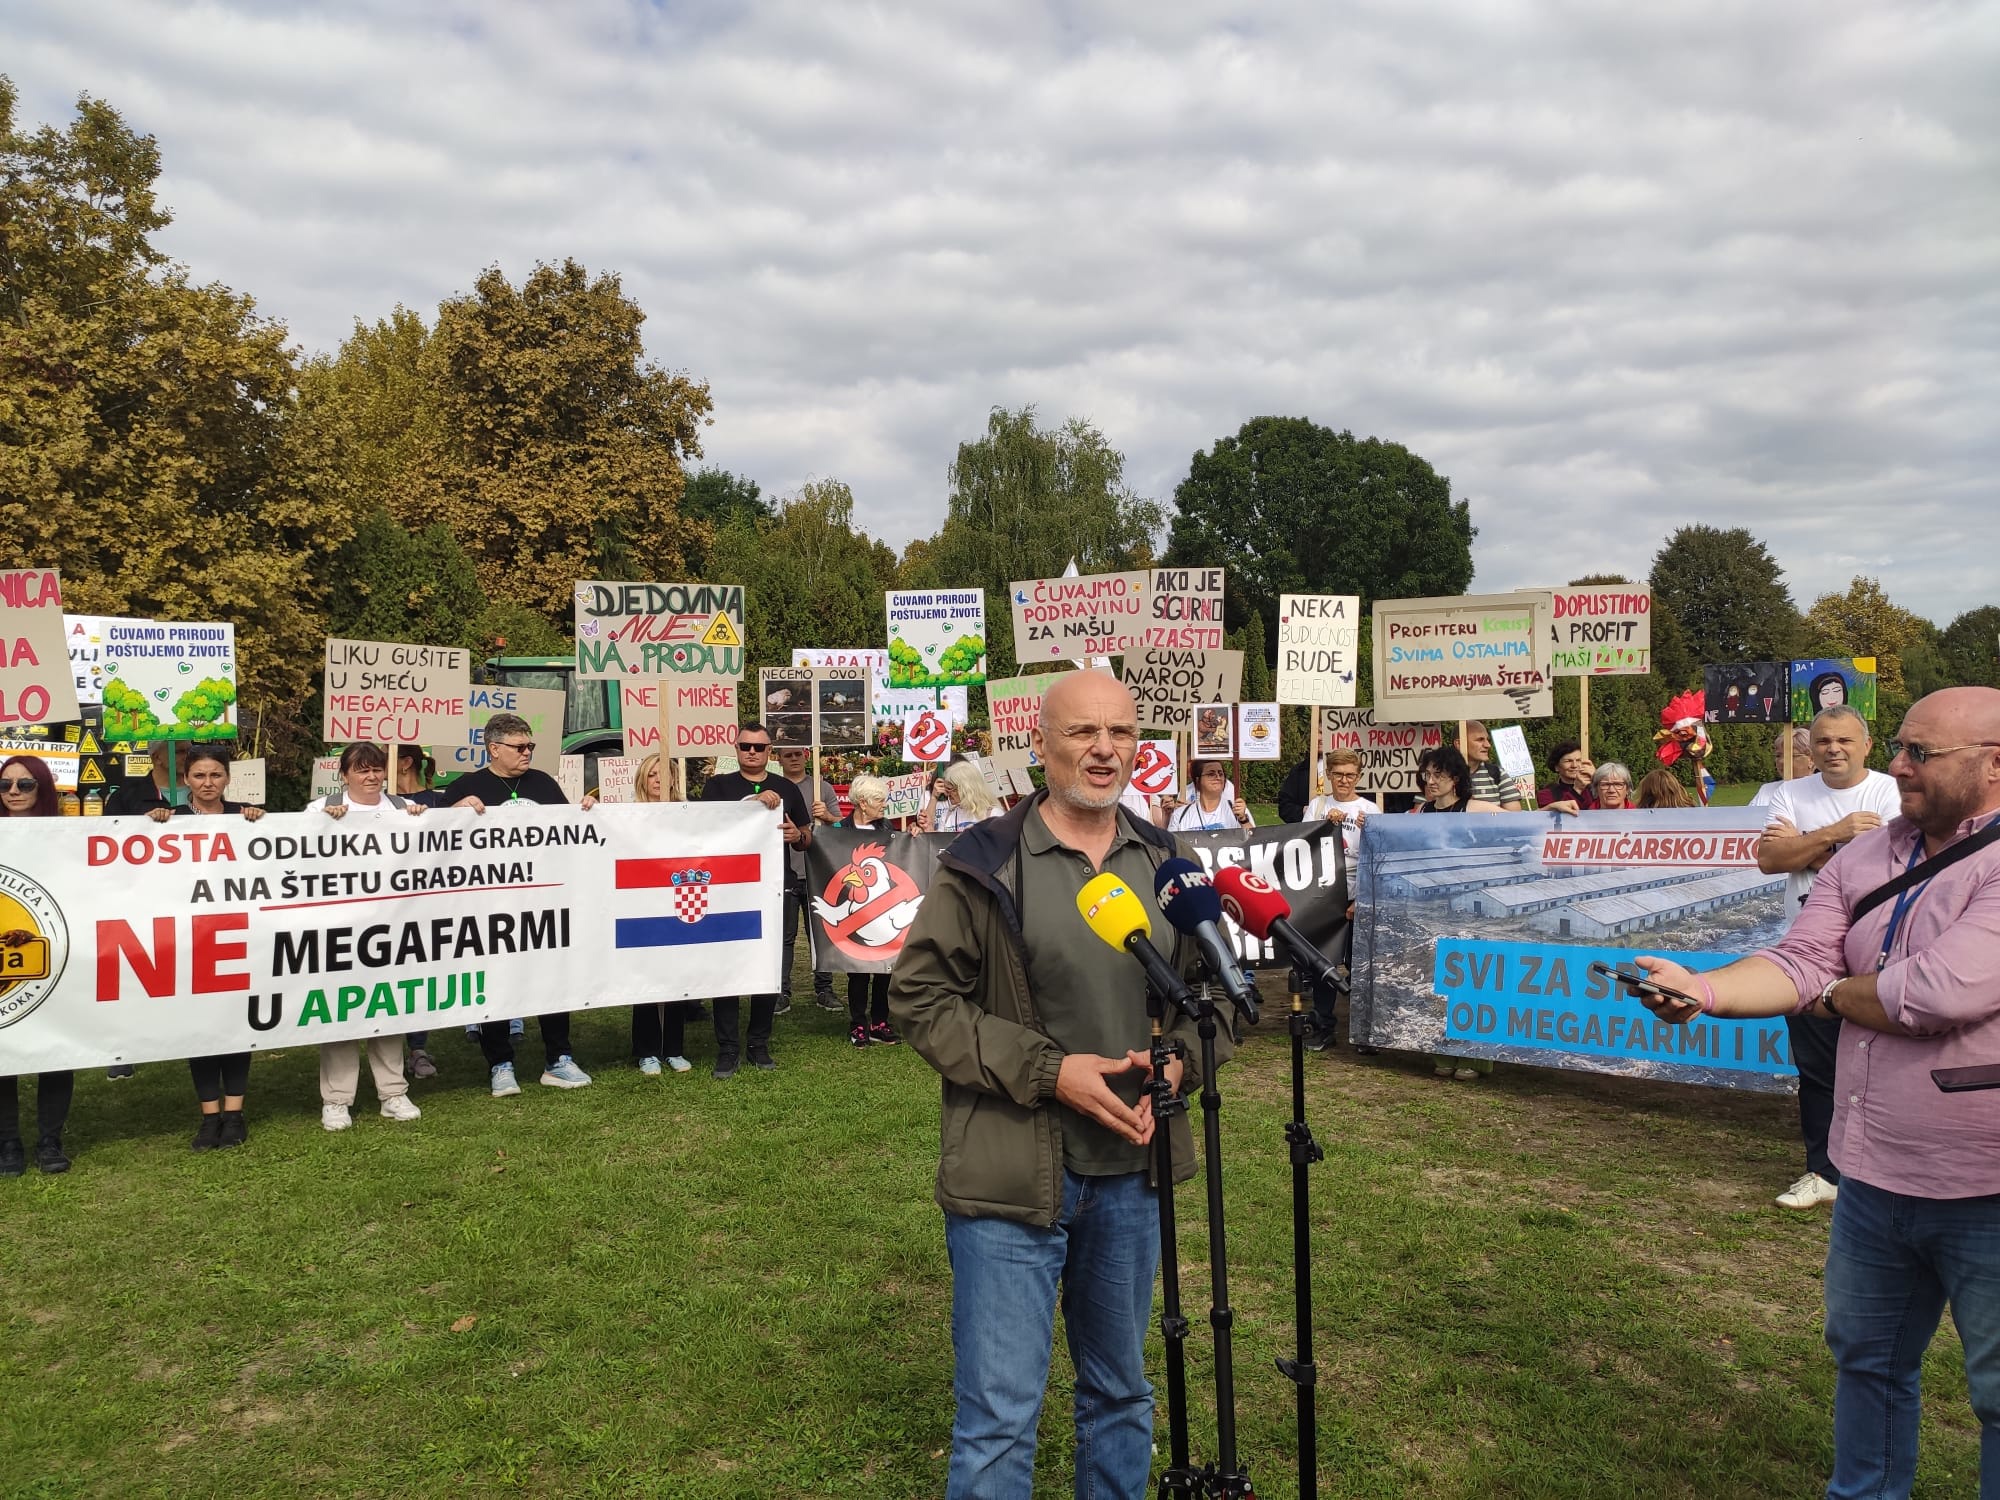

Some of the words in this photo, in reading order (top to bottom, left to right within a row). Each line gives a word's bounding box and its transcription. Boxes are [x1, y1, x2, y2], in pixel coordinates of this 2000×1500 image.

[1034, 579, 1126, 603] ČUVAJMO
[1156, 571, 1188, 591] AKO
[1195, 571, 1221, 592] JE
[584, 584, 744, 622] DJEDOVINA
[893, 594, 932, 606] ČUVAMO
[936, 594, 977, 605] PRIRODU
[1024, 598, 1140, 623] PODRAVINU
[1152, 593, 1223, 621] SIGURNO
[1290, 599, 1344, 618] NEKA
[1553, 594, 1650, 618] DOPUSTIMO
[890, 608, 947, 620] POŠTUJEMO
[950, 606, 981, 618] ŽIVOTE
[110, 626, 165, 641] ČUVAMO
[170, 628, 225, 641] PRIRODU
[617, 614, 709, 643] NIJE
[1029, 626, 1054, 640] ZA
[1064, 617, 1115, 638] NAŠU
[1280, 622, 1359, 648] BUDUĆNOST
[1390, 623, 1477, 639] PROFITERU
[1570, 621, 1638, 643] PROFIT
[106, 643, 184, 657] POŠTUJEMO
[188, 643, 230, 658] ŽIVOTE
[330, 644, 379, 665] LIKU
[391, 648, 461, 669] GUŠITE
[579, 638, 628, 674] NA
[640, 642, 744, 675] PRODAJU
[1145, 648, 1206, 669] ČUVAJ
[1287, 650, 1342, 673] BUDE
[1391, 646, 1444, 663] SVIMA
[1452, 641, 1529, 659] OSTALIMA
[762, 667, 813, 680] NEĆEMO
[830, 669, 857, 679] OVO
[1125, 667, 1204, 688] NAROD
[1218, 673, 1223, 689] I
[1795, 664, 1807, 672] DA
[331, 672, 347, 689] U
[360, 670, 427, 692] SMEĆU
[1279, 679, 1343, 701] ZELENA
[330, 695, 464, 716] MEGAFARME
[625, 688, 658, 707] NE
[677, 683, 734, 707] MIRIŠE
[330, 714, 420, 741] NEĆU
[629, 727, 660, 747] NA
[677, 724, 738, 746] DOBRO
[1332, 731, 1361, 749] IMA
[1368, 728, 1416, 747] PRAVO
[1422, 728, 1441, 746] NA
[88, 833, 236, 866] DOSTA
[248, 832, 382, 860] ODLUKA
[391, 832, 410, 854] U
[419, 829, 463, 853] IME
[469, 824, 606, 850] GRAĐANA,
[1542, 838, 1571, 859] NE
[1575, 833, 1717, 860] PILIĆARSKOJ
[191, 880, 214, 903] A
[225, 877, 272, 900] NA
[281, 870, 381, 899] ŠTETU
[390, 862, 534, 891] GRAĐANA!
[271, 908, 570, 977] MEGAFARMI
[96, 912, 250, 1002] NE
[1443, 951, 1505, 991] SVI
[1518, 956, 1571, 998] ZA
[248, 993, 282, 1031] U
[297, 971, 485, 1027] APATIJI!
[1452, 1001, 1497, 1034] OD
[1508, 1007, 1719, 1059] MEGAFARMI
[1735, 1026, 1744, 1060] I
[1759, 1029, 1794, 1066] K
